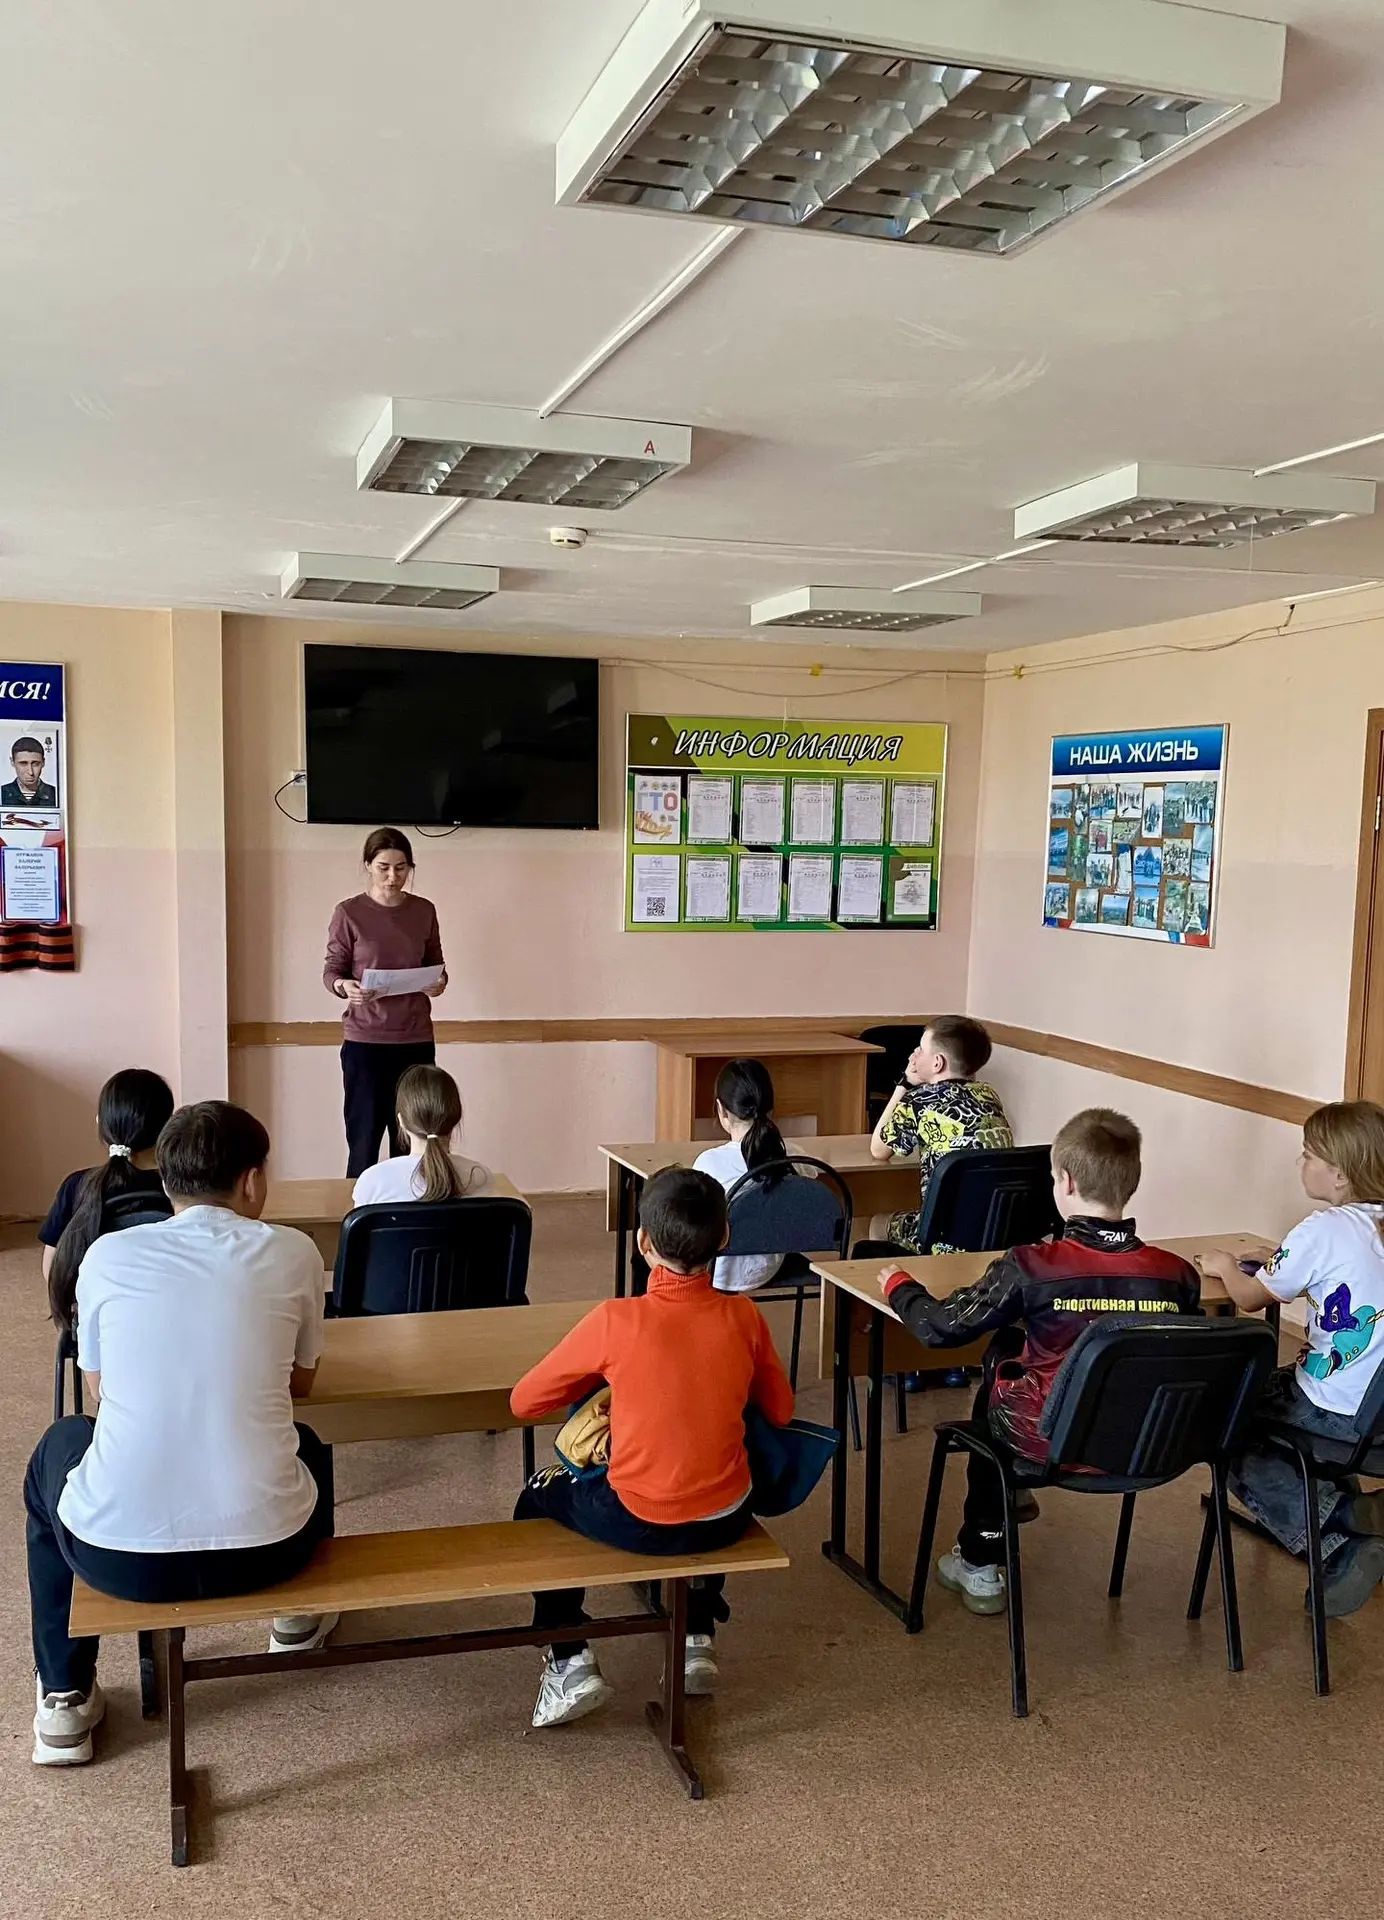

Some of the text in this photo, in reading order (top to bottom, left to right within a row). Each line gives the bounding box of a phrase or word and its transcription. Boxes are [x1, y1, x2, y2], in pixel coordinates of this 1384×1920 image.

[674, 730, 903, 765] ИНФОРМАЦИЯ
[1070, 740, 1199, 766] НАША ЖИЗНЬ
[637, 791, 678, 812] ГТО
[1053, 1298, 1136, 1313] Спортивная
